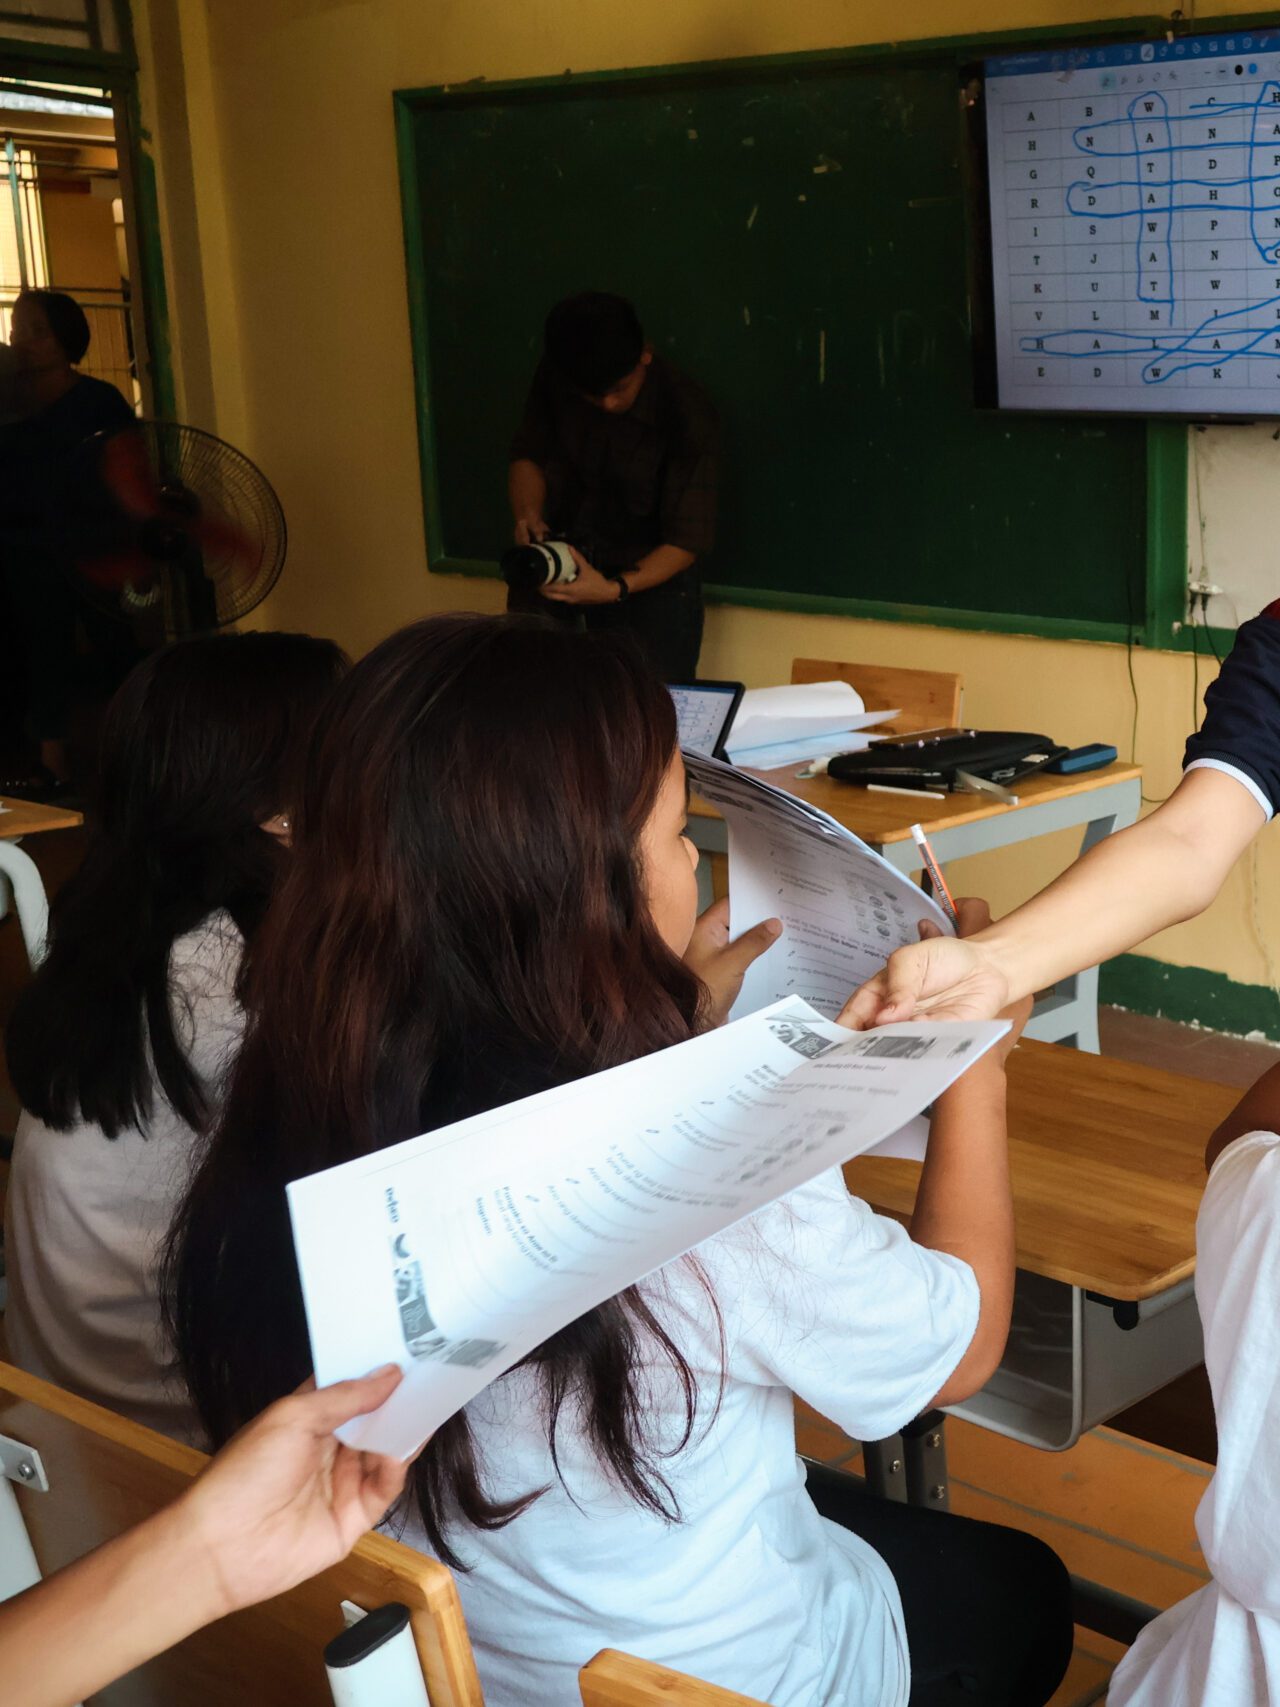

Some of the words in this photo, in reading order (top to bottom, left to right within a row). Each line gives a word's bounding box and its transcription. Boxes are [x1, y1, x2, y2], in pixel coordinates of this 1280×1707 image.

[1026, 111, 1036, 123] A
[1084, 105, 1094, 118] B
[1143, 101, 1155, 114] W
[1027, 139, 1038, 152] H
[1085, 135, 1095, 148] N
[1145, 132, 1155, 144] A
[1207, 127, 1217, 140] N
[1028, 168, 1039, 181] G
[1085, 165, 1096, 180] Q
[1145, 161, 1156, 174] T
[1207, 158, 1218, 171] D
[1030, 197, 1040, 210] R
[1087, 195, 1097, 207] D
[1146, 192, 1157, 205] A
[1208, 189, 1219, 202] H
[1033, 226, 1039, 239] I
[1088, 223, 1098, 236] S
[1146, 221, 1158, 234] W
[1209, 219, 1219, 232] P
[1032, 254, 1042, 267] T
[1089, 253, 1098, 265] J
[1148, 251, 1158, 264] A
[1210, 249, 1220, 262] N
[1033, 283, 1043, 295] K
[1090, 281, 1100, 293] U
[1149, 280, 1159, 293] T
[1209, 279, 1222, 291] W
[1034, 310, 1044, 322] V
[1091, 310, 1101, 322] L
[1149, 309, 1161, 322] M
[1092, 338, 1102, 350] A
[1211, 338, 1222, 350] A
[1036, 366, 1046, 379] E
[1093, 366, 1103, 379] D
[1150, 367, 1162, 379] W
[1212, 367, 1223, 380] K
